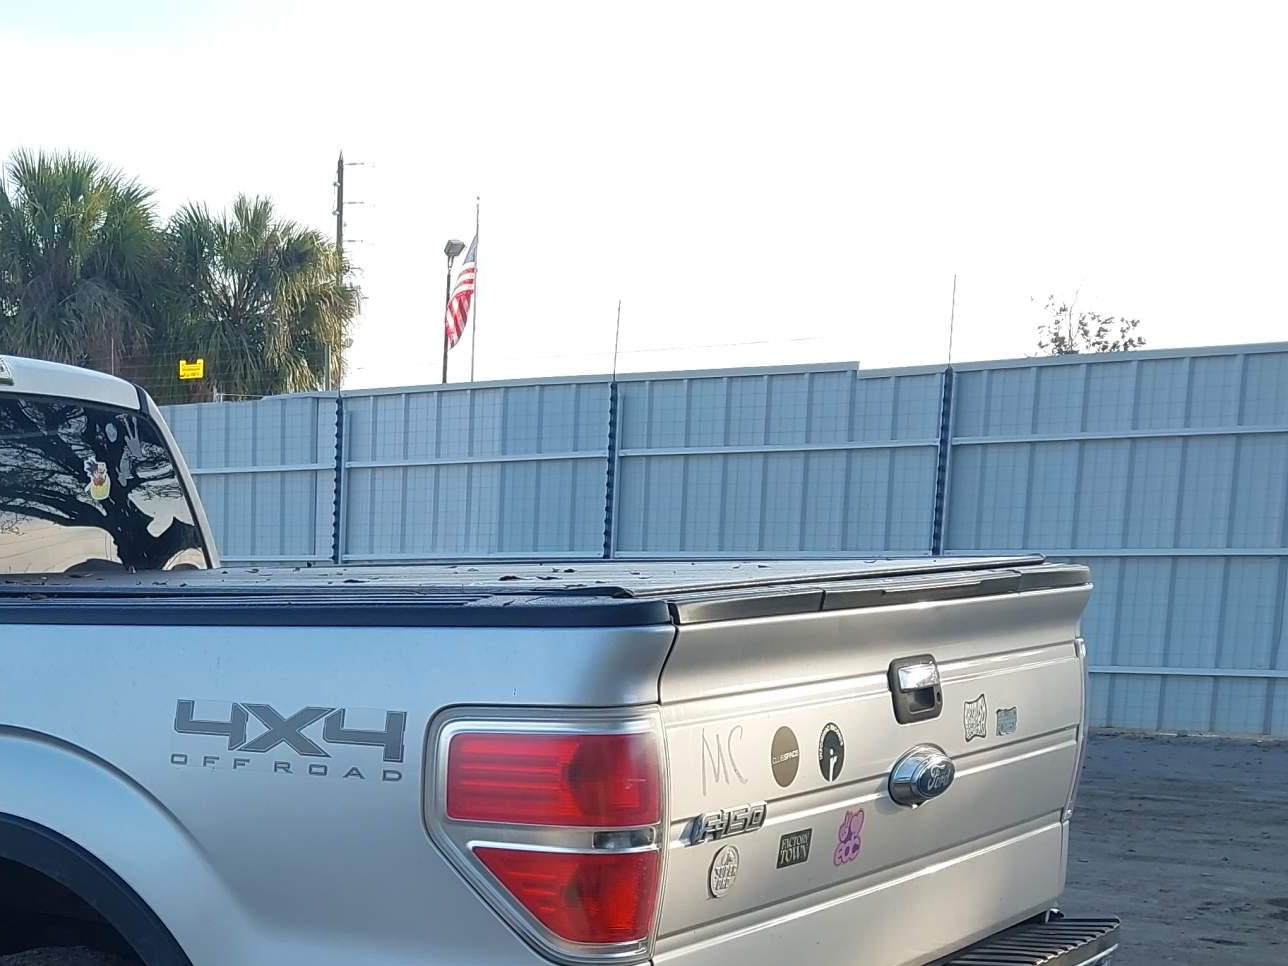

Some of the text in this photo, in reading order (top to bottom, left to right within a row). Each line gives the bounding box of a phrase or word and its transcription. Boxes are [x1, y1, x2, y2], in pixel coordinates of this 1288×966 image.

[170, 753, 404, 782] OFF ROAD
[927, 762, 951, 791] Ford
